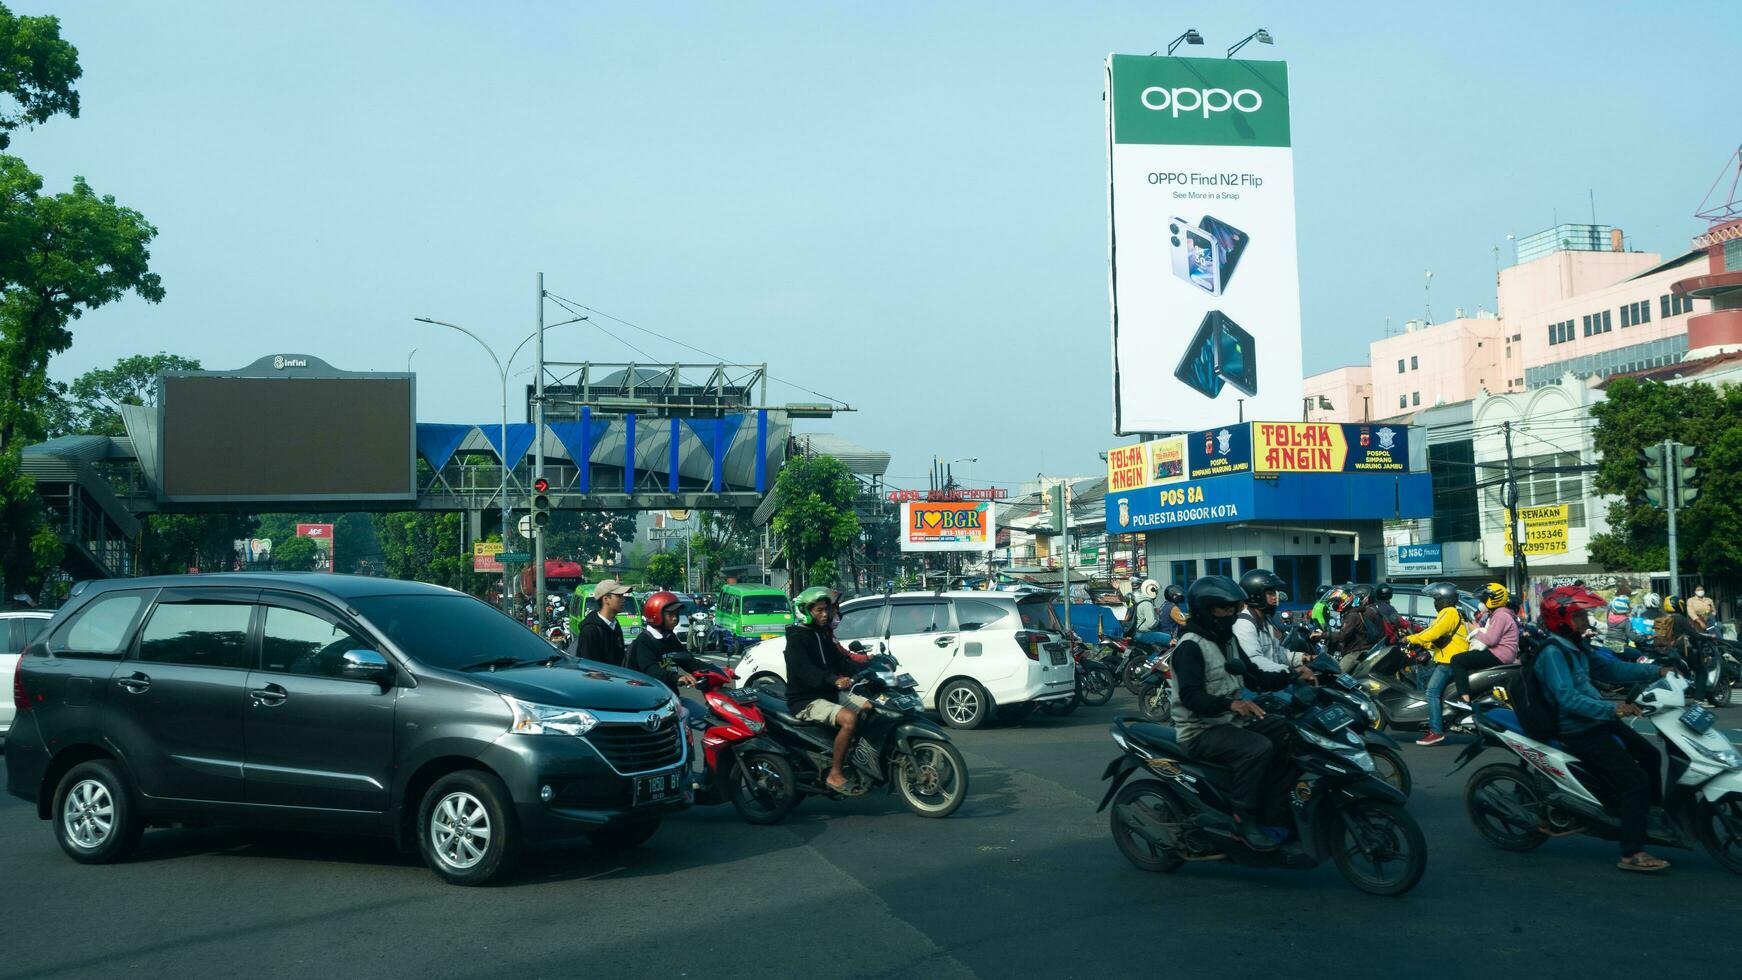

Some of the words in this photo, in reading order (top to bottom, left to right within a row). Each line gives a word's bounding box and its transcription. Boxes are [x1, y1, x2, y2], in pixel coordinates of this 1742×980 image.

[1141, 86, 1262, 118] oppo
[1148, 173, 1187, 185] OPPO
[1191, 173, 1217, 185] Find
[1220, 174, 1238, 186] N2
[1241, 174, 1263, 188] Flip
[1173, 191, 1187, 199] See
[1221, 192, 1240, 200] Snap
[1261, 425, 1332, 447] TOLAK
[1110, 447, 1143, 469] TOLAK
[1210, 458, 1228, 466] POSPOL
[1265, 448, 1332, 470] ANGIN
[1112, 467, 1143, 490] ANGIN
[1160, 488, 1185, 507] POS
[1187, 486, 1204, 503] 8A
[914, 510, 924, 528] I
[941, 510, 981, 528] BGR
[1133, 511, 1176, 527] POLRESTA
[1177, 507, 1210, 522] BOGOR
[1211, 504, 1238, 518] KOTA
[1522, 509, 1560, 519] SEWAKAN
[1509, 529, 1563, 541] 1135346
[1507, 541, 1566, 552] 028997575
